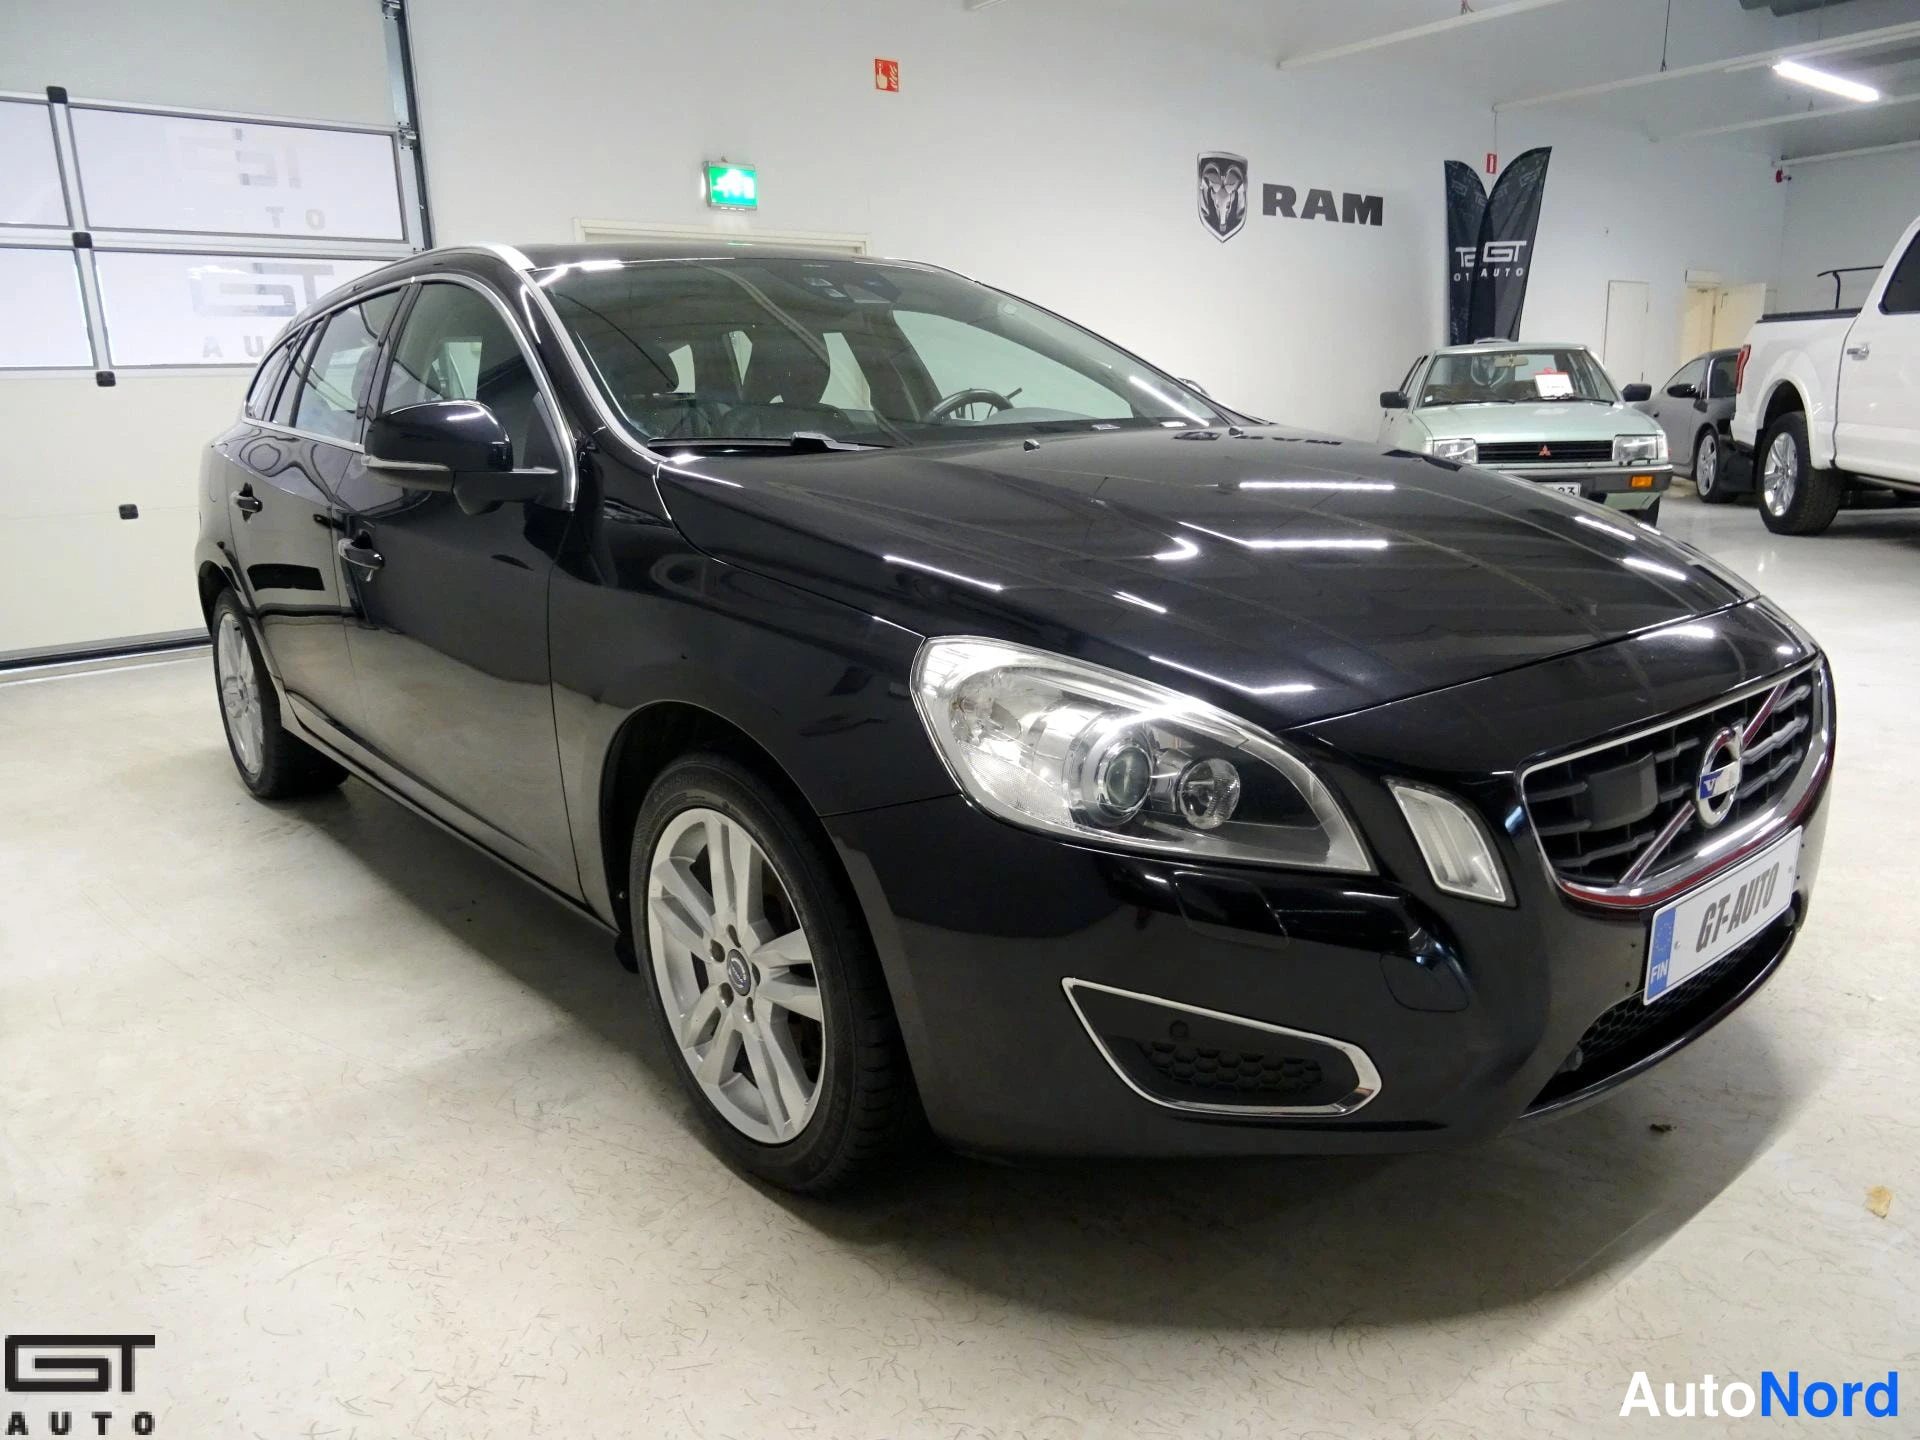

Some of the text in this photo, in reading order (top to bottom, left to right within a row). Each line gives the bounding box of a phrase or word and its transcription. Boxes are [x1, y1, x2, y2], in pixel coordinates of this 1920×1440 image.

[1262, 183, 1384, 226] RAM
[1480, 267, 1524, 279] AUTO
[201, 335, 264, 359] AU
[1695, 862, 1780, 953] GT-AUTO
[1650, 959, 1670, 985] FIN
